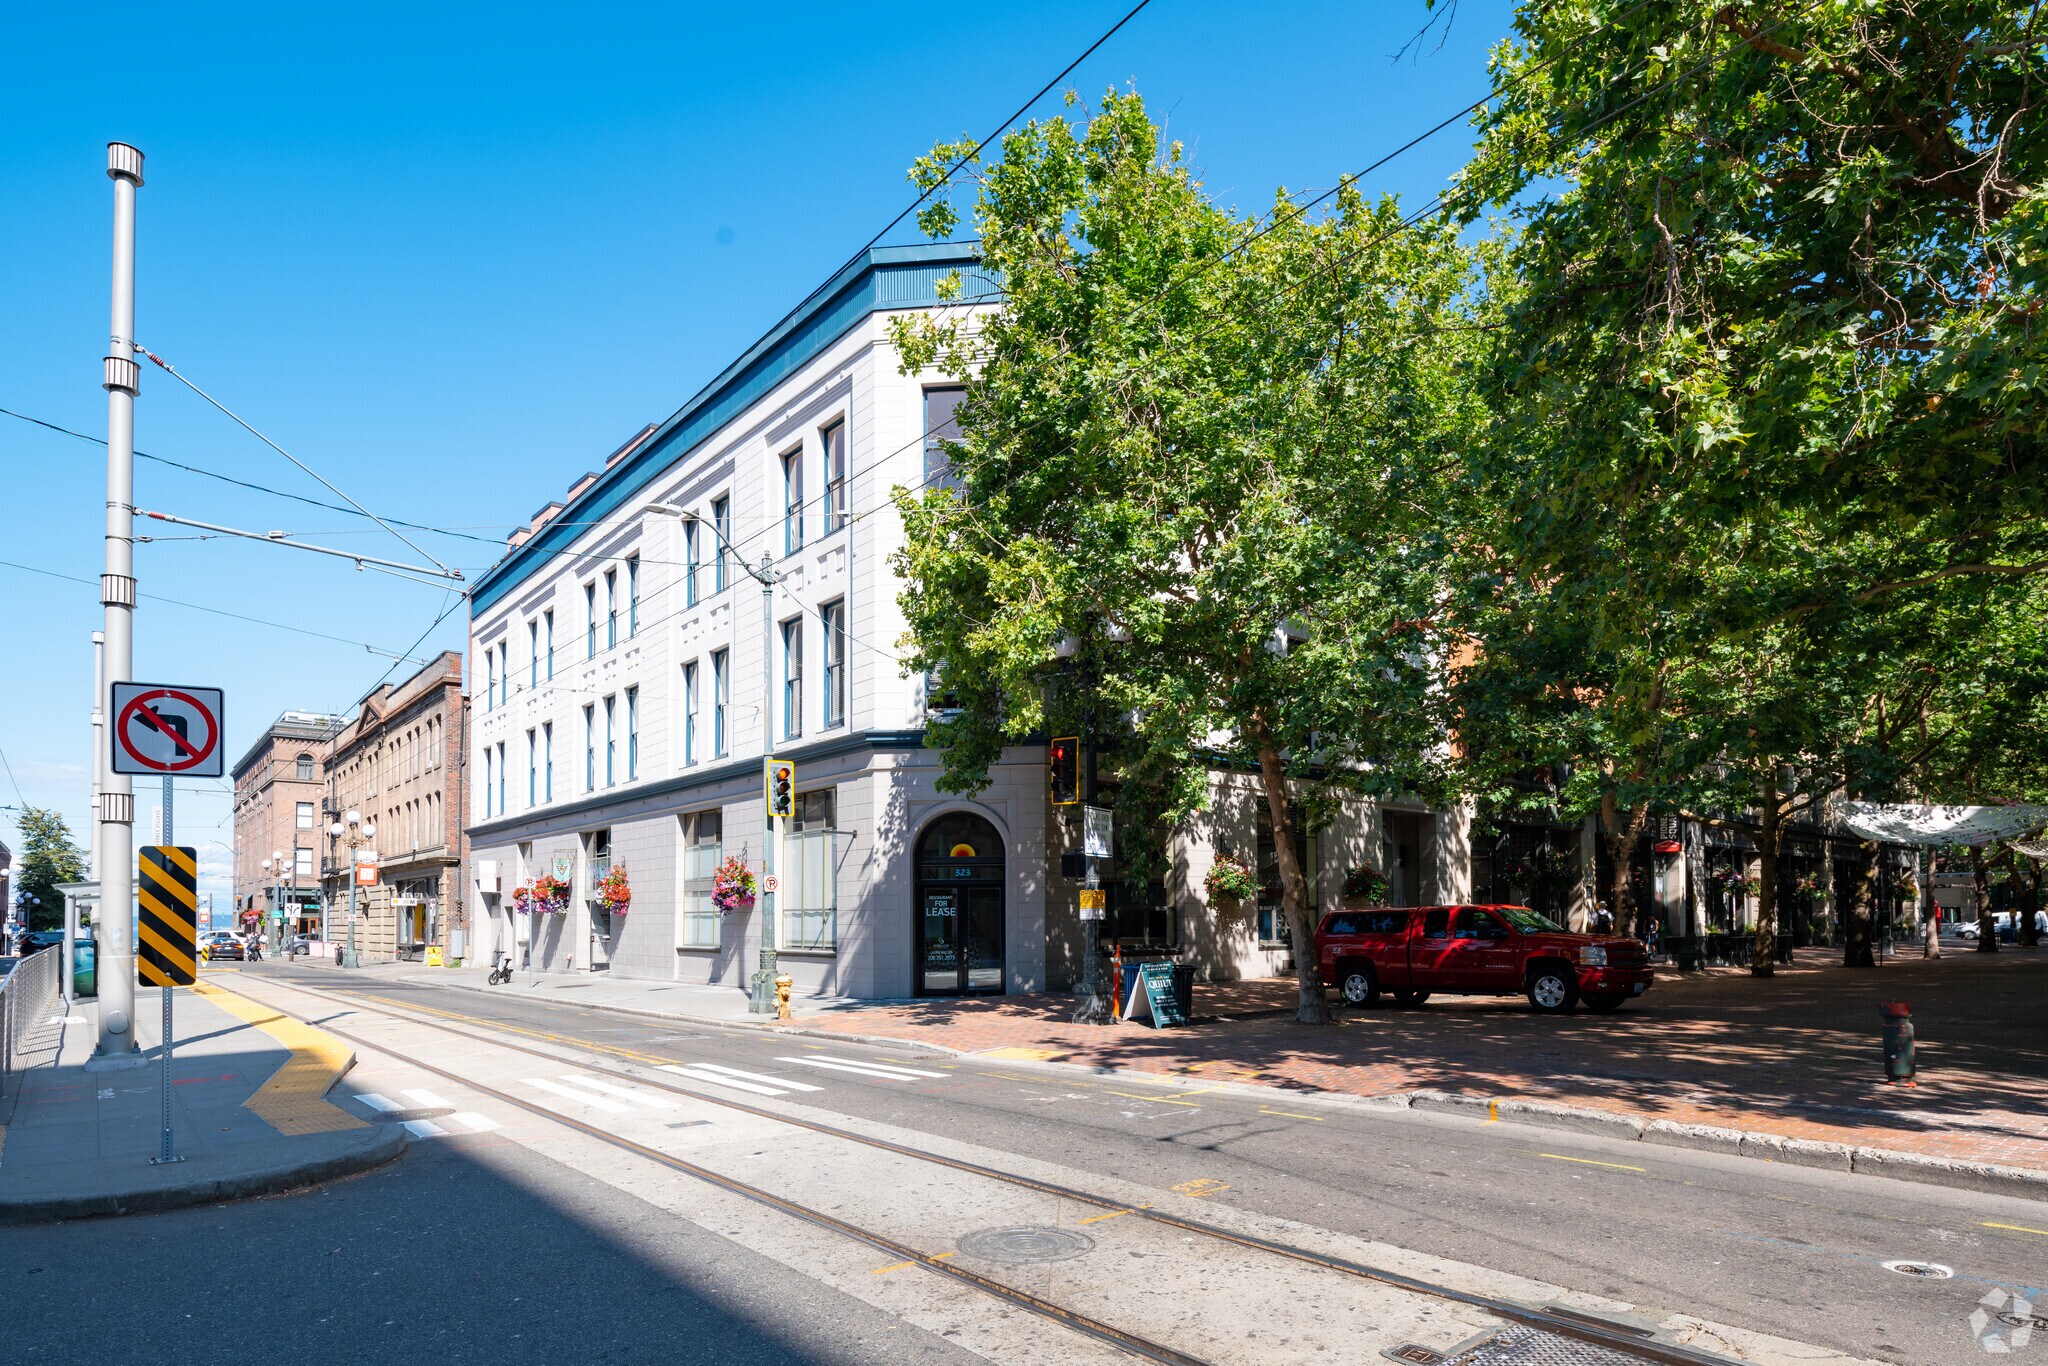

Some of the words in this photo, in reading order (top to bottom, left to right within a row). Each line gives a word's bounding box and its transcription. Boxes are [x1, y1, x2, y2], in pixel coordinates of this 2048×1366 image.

[954, 868, 971, 877] 323
[926, 907, 956, 917] LEASE
[1148, 979, 1173, 989] QUILT
